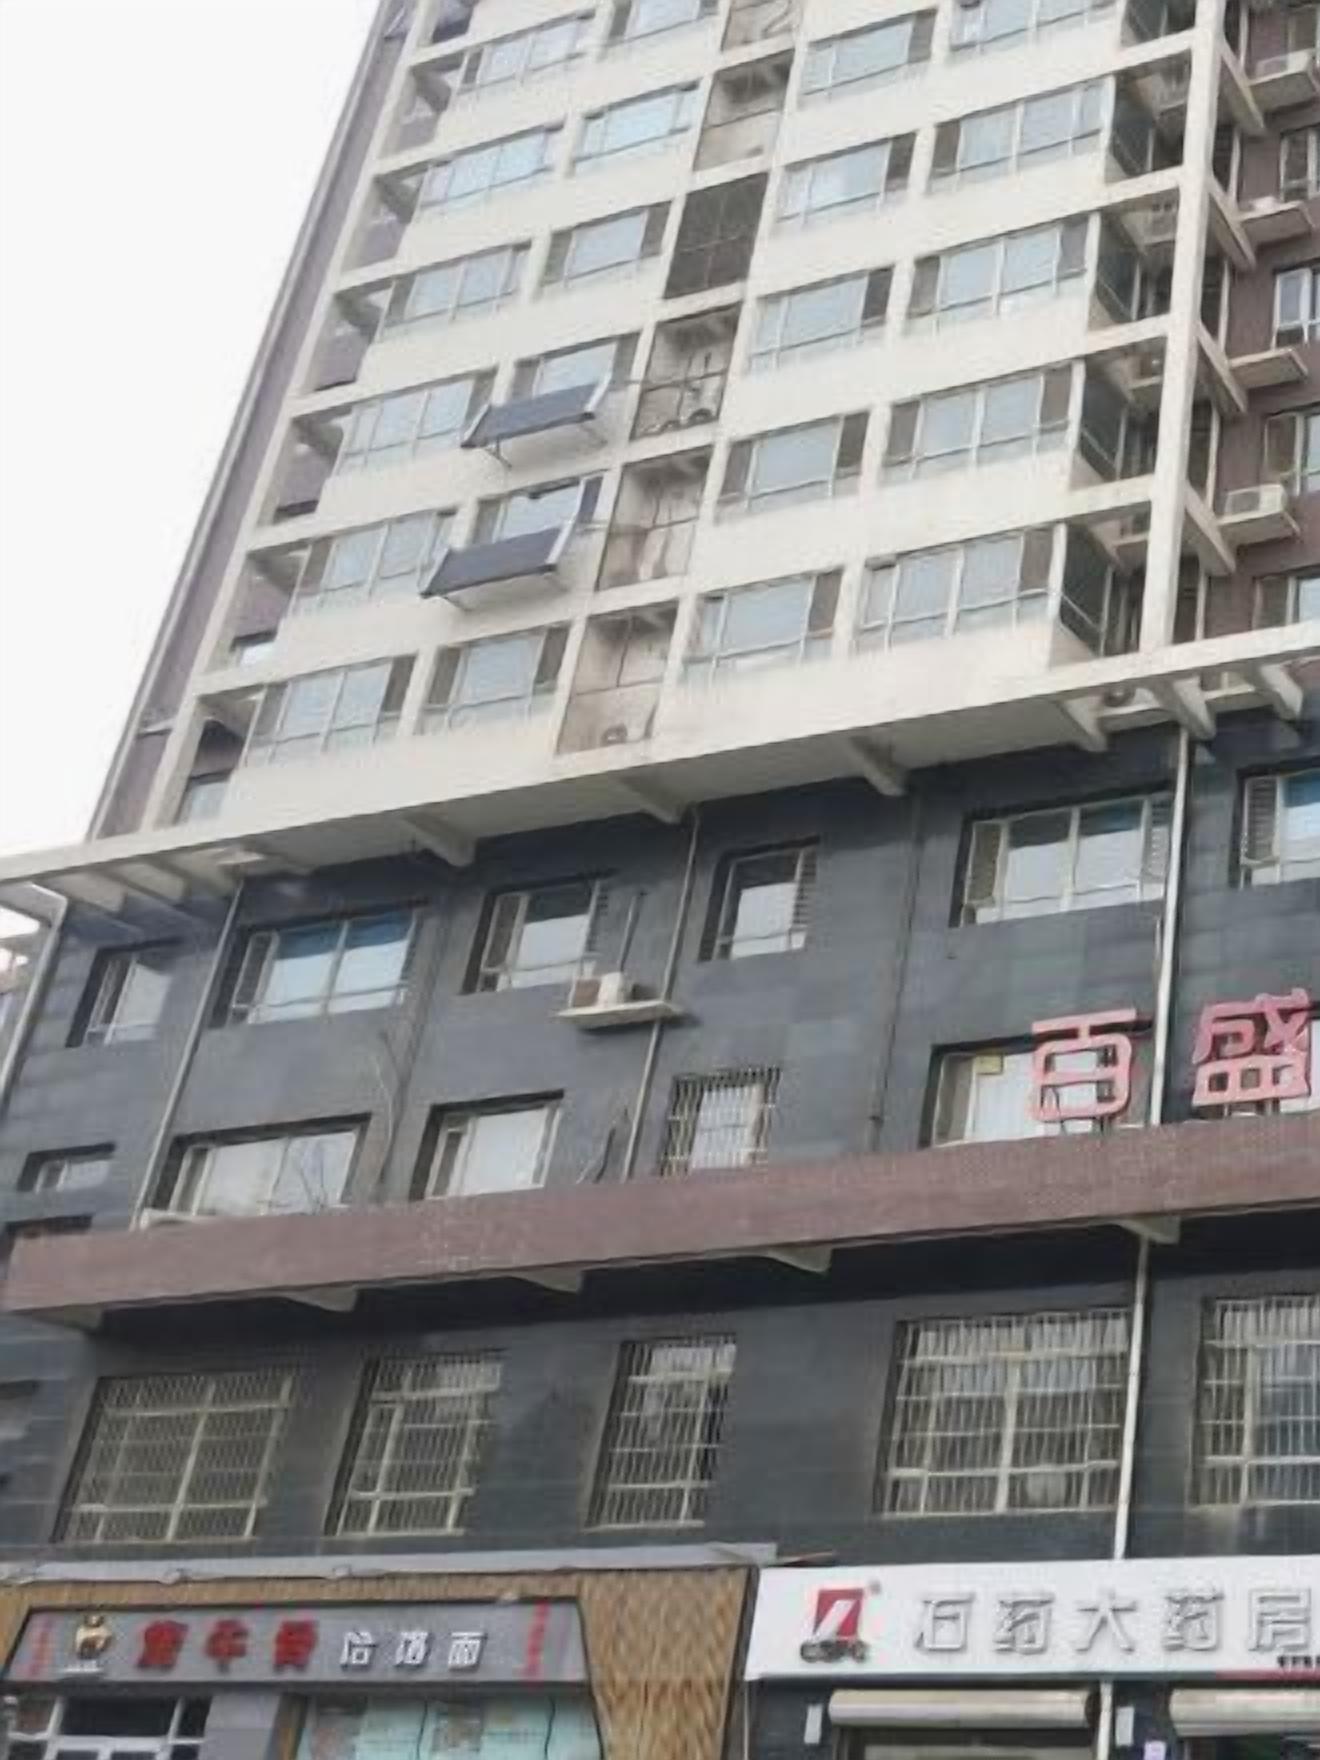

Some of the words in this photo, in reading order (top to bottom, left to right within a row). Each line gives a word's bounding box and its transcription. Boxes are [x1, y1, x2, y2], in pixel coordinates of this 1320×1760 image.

[914, 1586, 1312, 1655] 石药大药房
